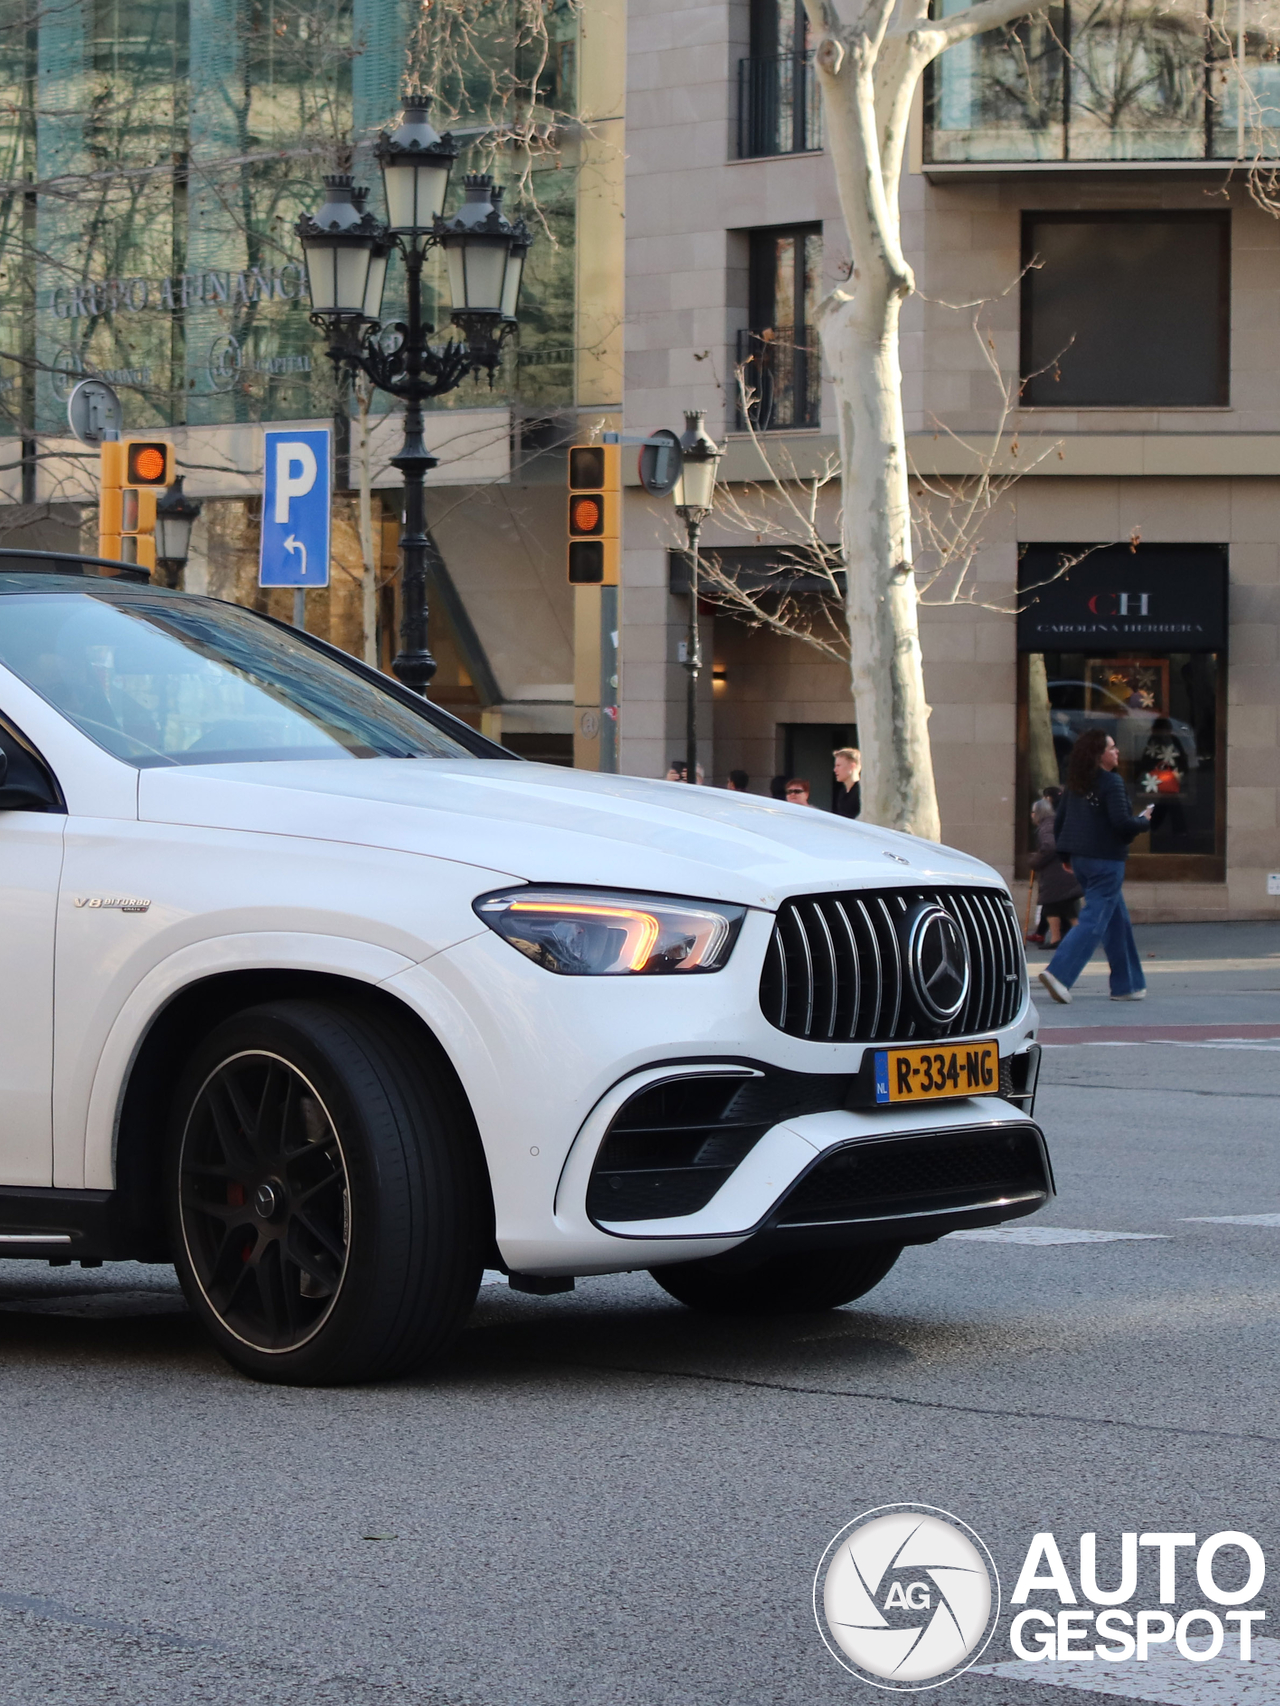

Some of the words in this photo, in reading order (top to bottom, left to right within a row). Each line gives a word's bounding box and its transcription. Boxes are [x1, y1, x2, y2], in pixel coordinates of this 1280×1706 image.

[51, 277, 147, 319] GRUPO
[275, 442, 317, 523] P
[1087, 592, 1152, 615] CH
[1036, 624, 1118, 632] CAROLINA
[1124, 624, 1204, 632] HERRERA
[74, 898, 103, 908] V8
[103, 898, 151, 906] BITURBO
[897, 1050, 993, 1094] R-334-NG
[876, 1082, 887, 1094] NL
